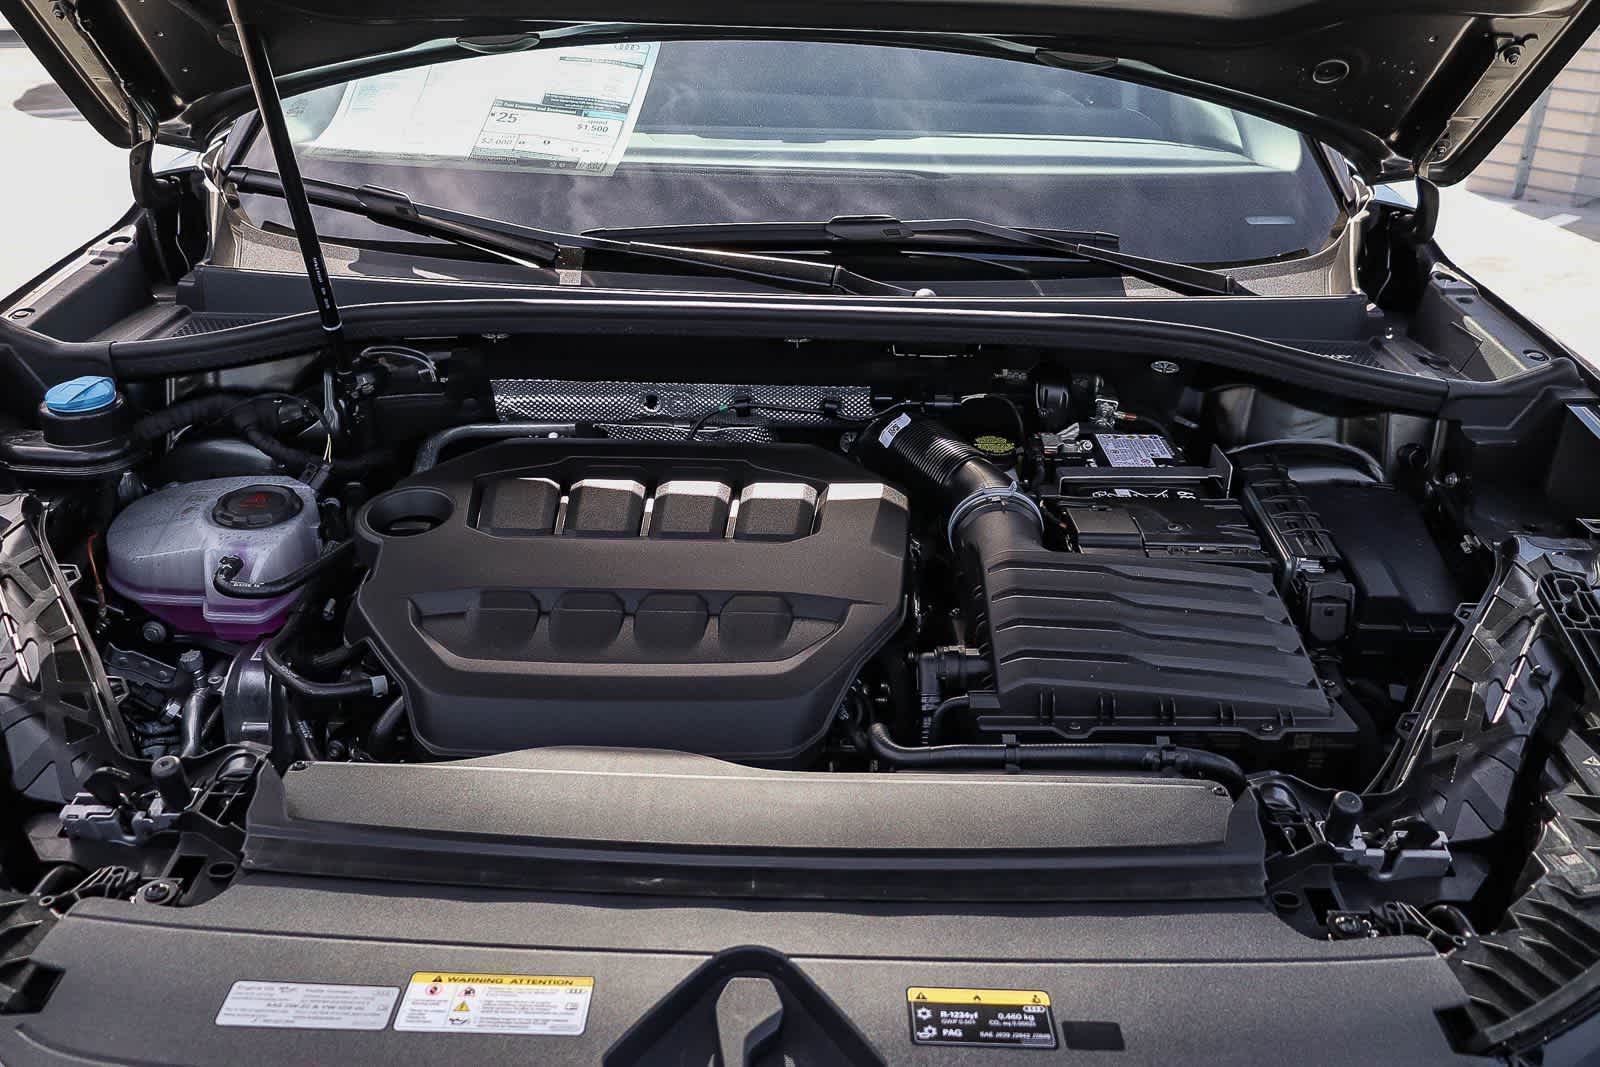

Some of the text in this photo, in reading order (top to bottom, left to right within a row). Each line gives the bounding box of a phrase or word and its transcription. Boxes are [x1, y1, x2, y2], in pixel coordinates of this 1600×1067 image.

[495, 111, 519, 124] 25
[447, 976, 574, 986] WARNING ATTENTION
[940, 1010, 979, 1019] R-1234yf
[1023, 1013, 1035, 1021] kg
[942, 1028, 963, 1037] PAG
